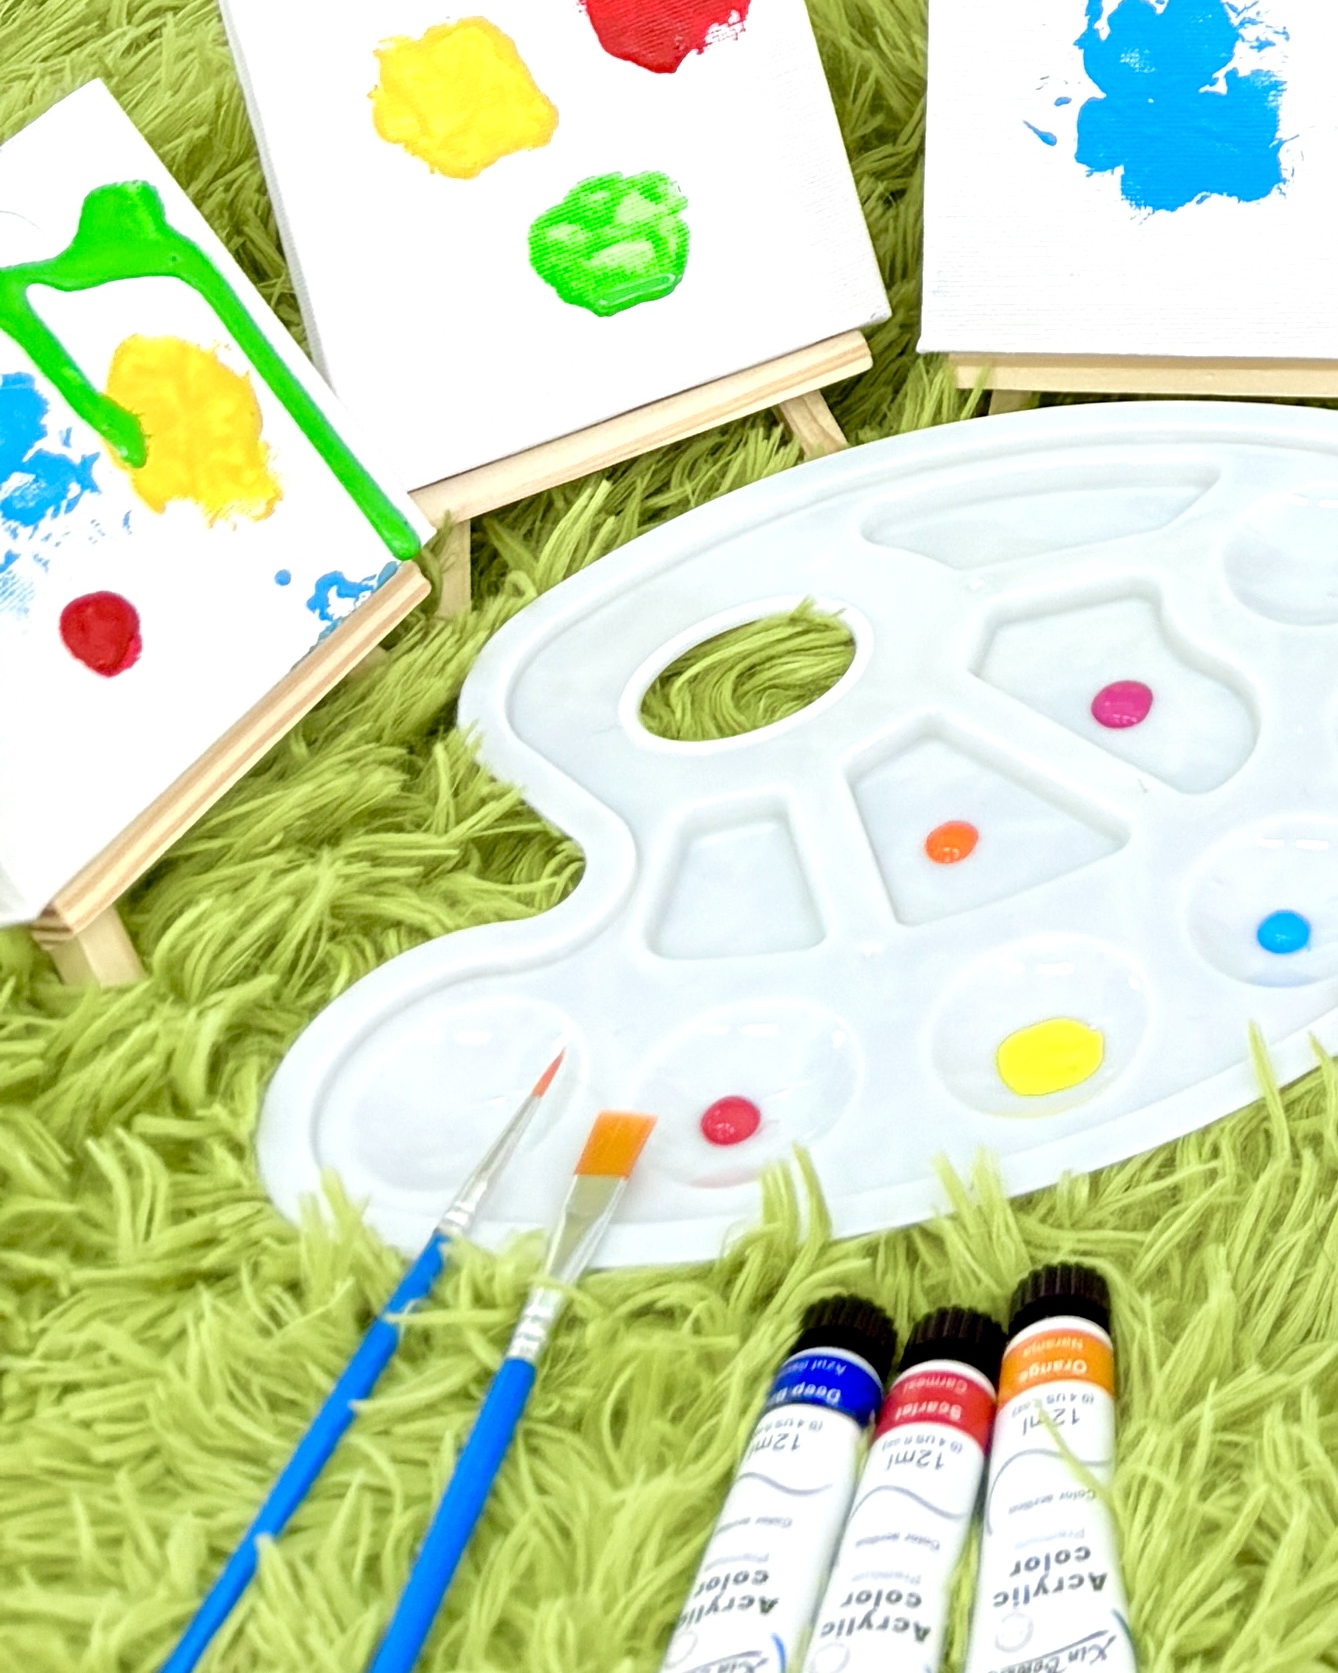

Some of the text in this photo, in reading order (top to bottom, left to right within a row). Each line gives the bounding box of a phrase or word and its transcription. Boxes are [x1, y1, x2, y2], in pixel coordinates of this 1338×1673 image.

[1018, 1358, 1086, 1382] Orange
[887, 1449, 943, 1470] 12ml
[1008, 1546, 1090, 1576] color
[694, 1569, 768, 1597] color
[992, 1572, 1107, 1608] Acrylic
[839, 1589, 921, 1608] color
[820, 1607, 930, 1643] Acrylic
